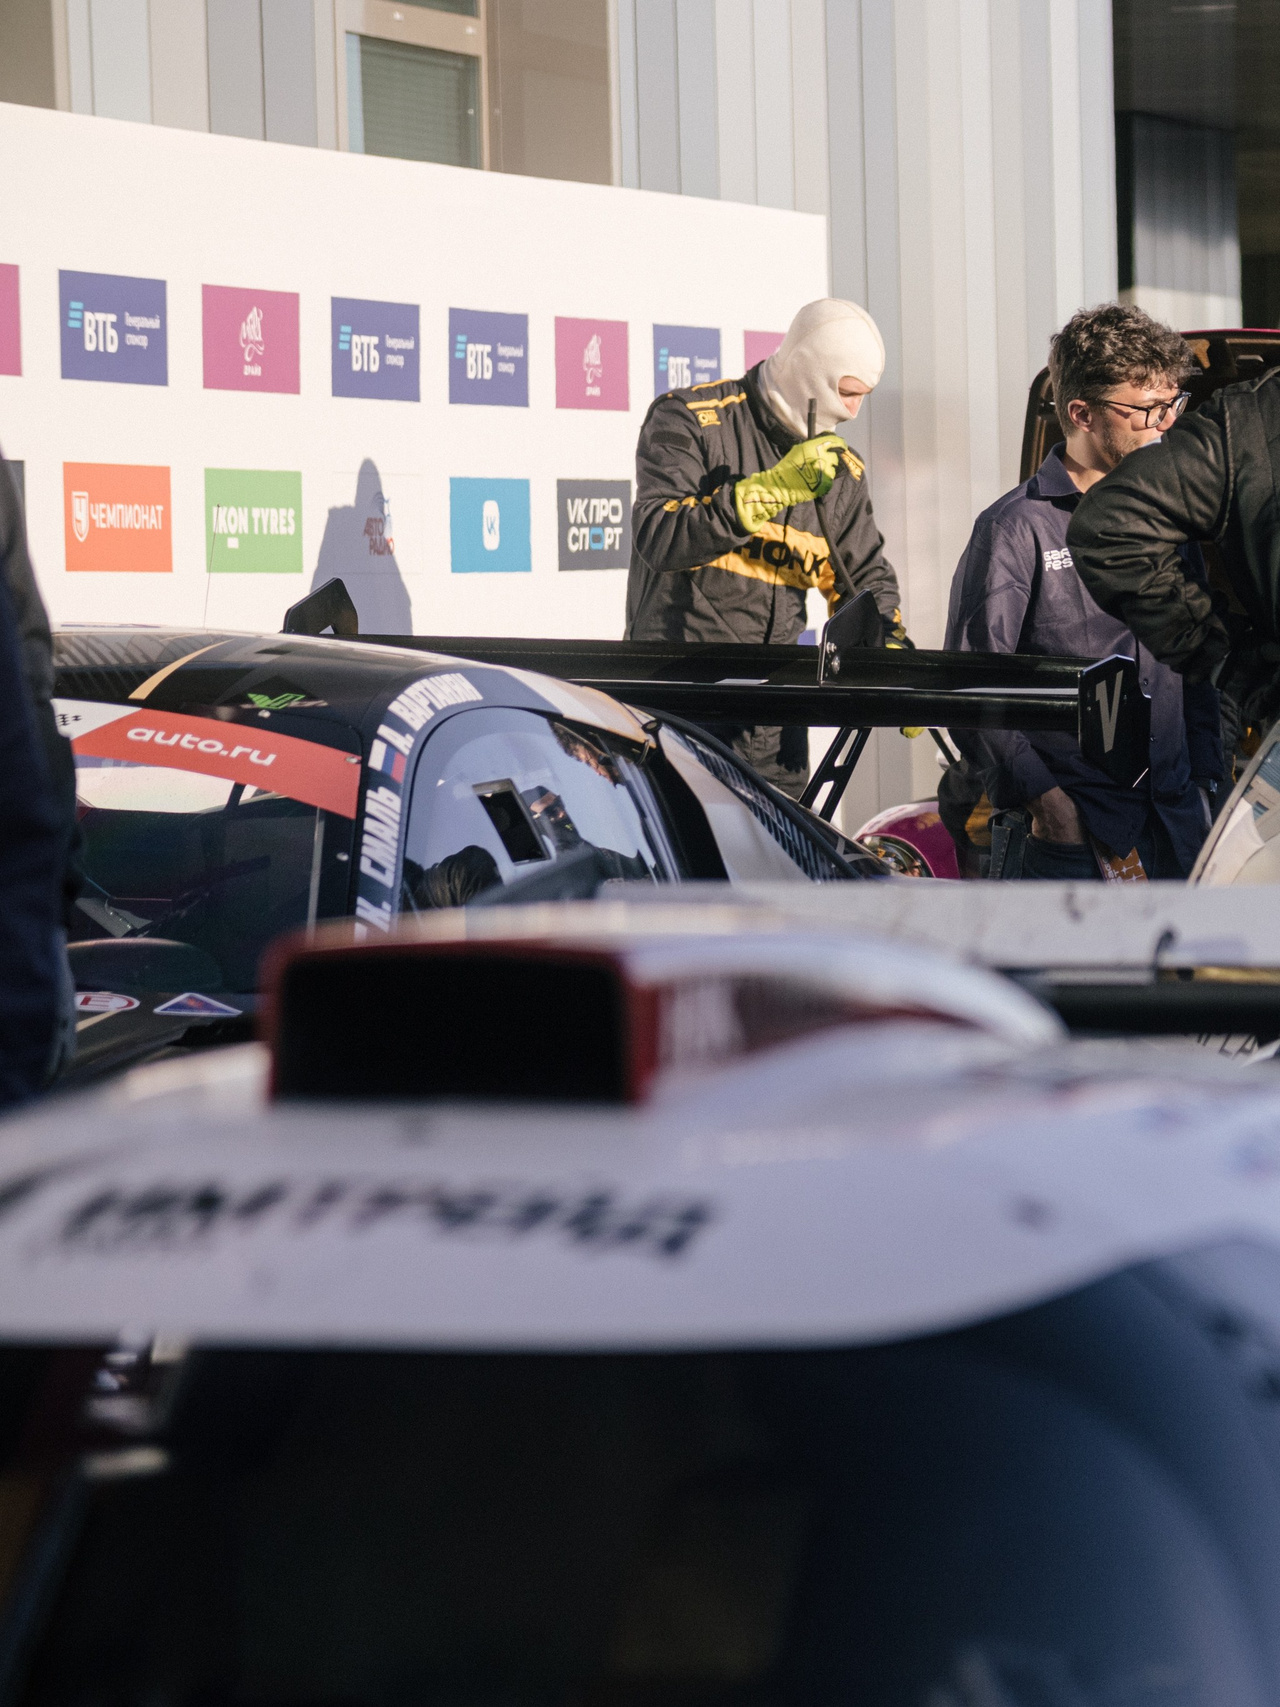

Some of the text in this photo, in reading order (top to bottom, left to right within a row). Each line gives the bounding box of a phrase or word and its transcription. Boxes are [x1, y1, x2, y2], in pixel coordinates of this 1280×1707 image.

[84, 311, 118, 353] ВТБ
[351, 334, 380, 373] ВТБ
[466, 343, 493, 380] ВТБ
[667, 356, 691, 389] ВТБ
[90, 503, 164, 530] ЧЕМПИОНАТ
[212, 506, 296, 536] IKON TYRES
[567, 526, 623, 553] СПОРТ
[127, 727, 277, 766] auto.ru
[359, 786, 402, 889] СМАЛЬ
